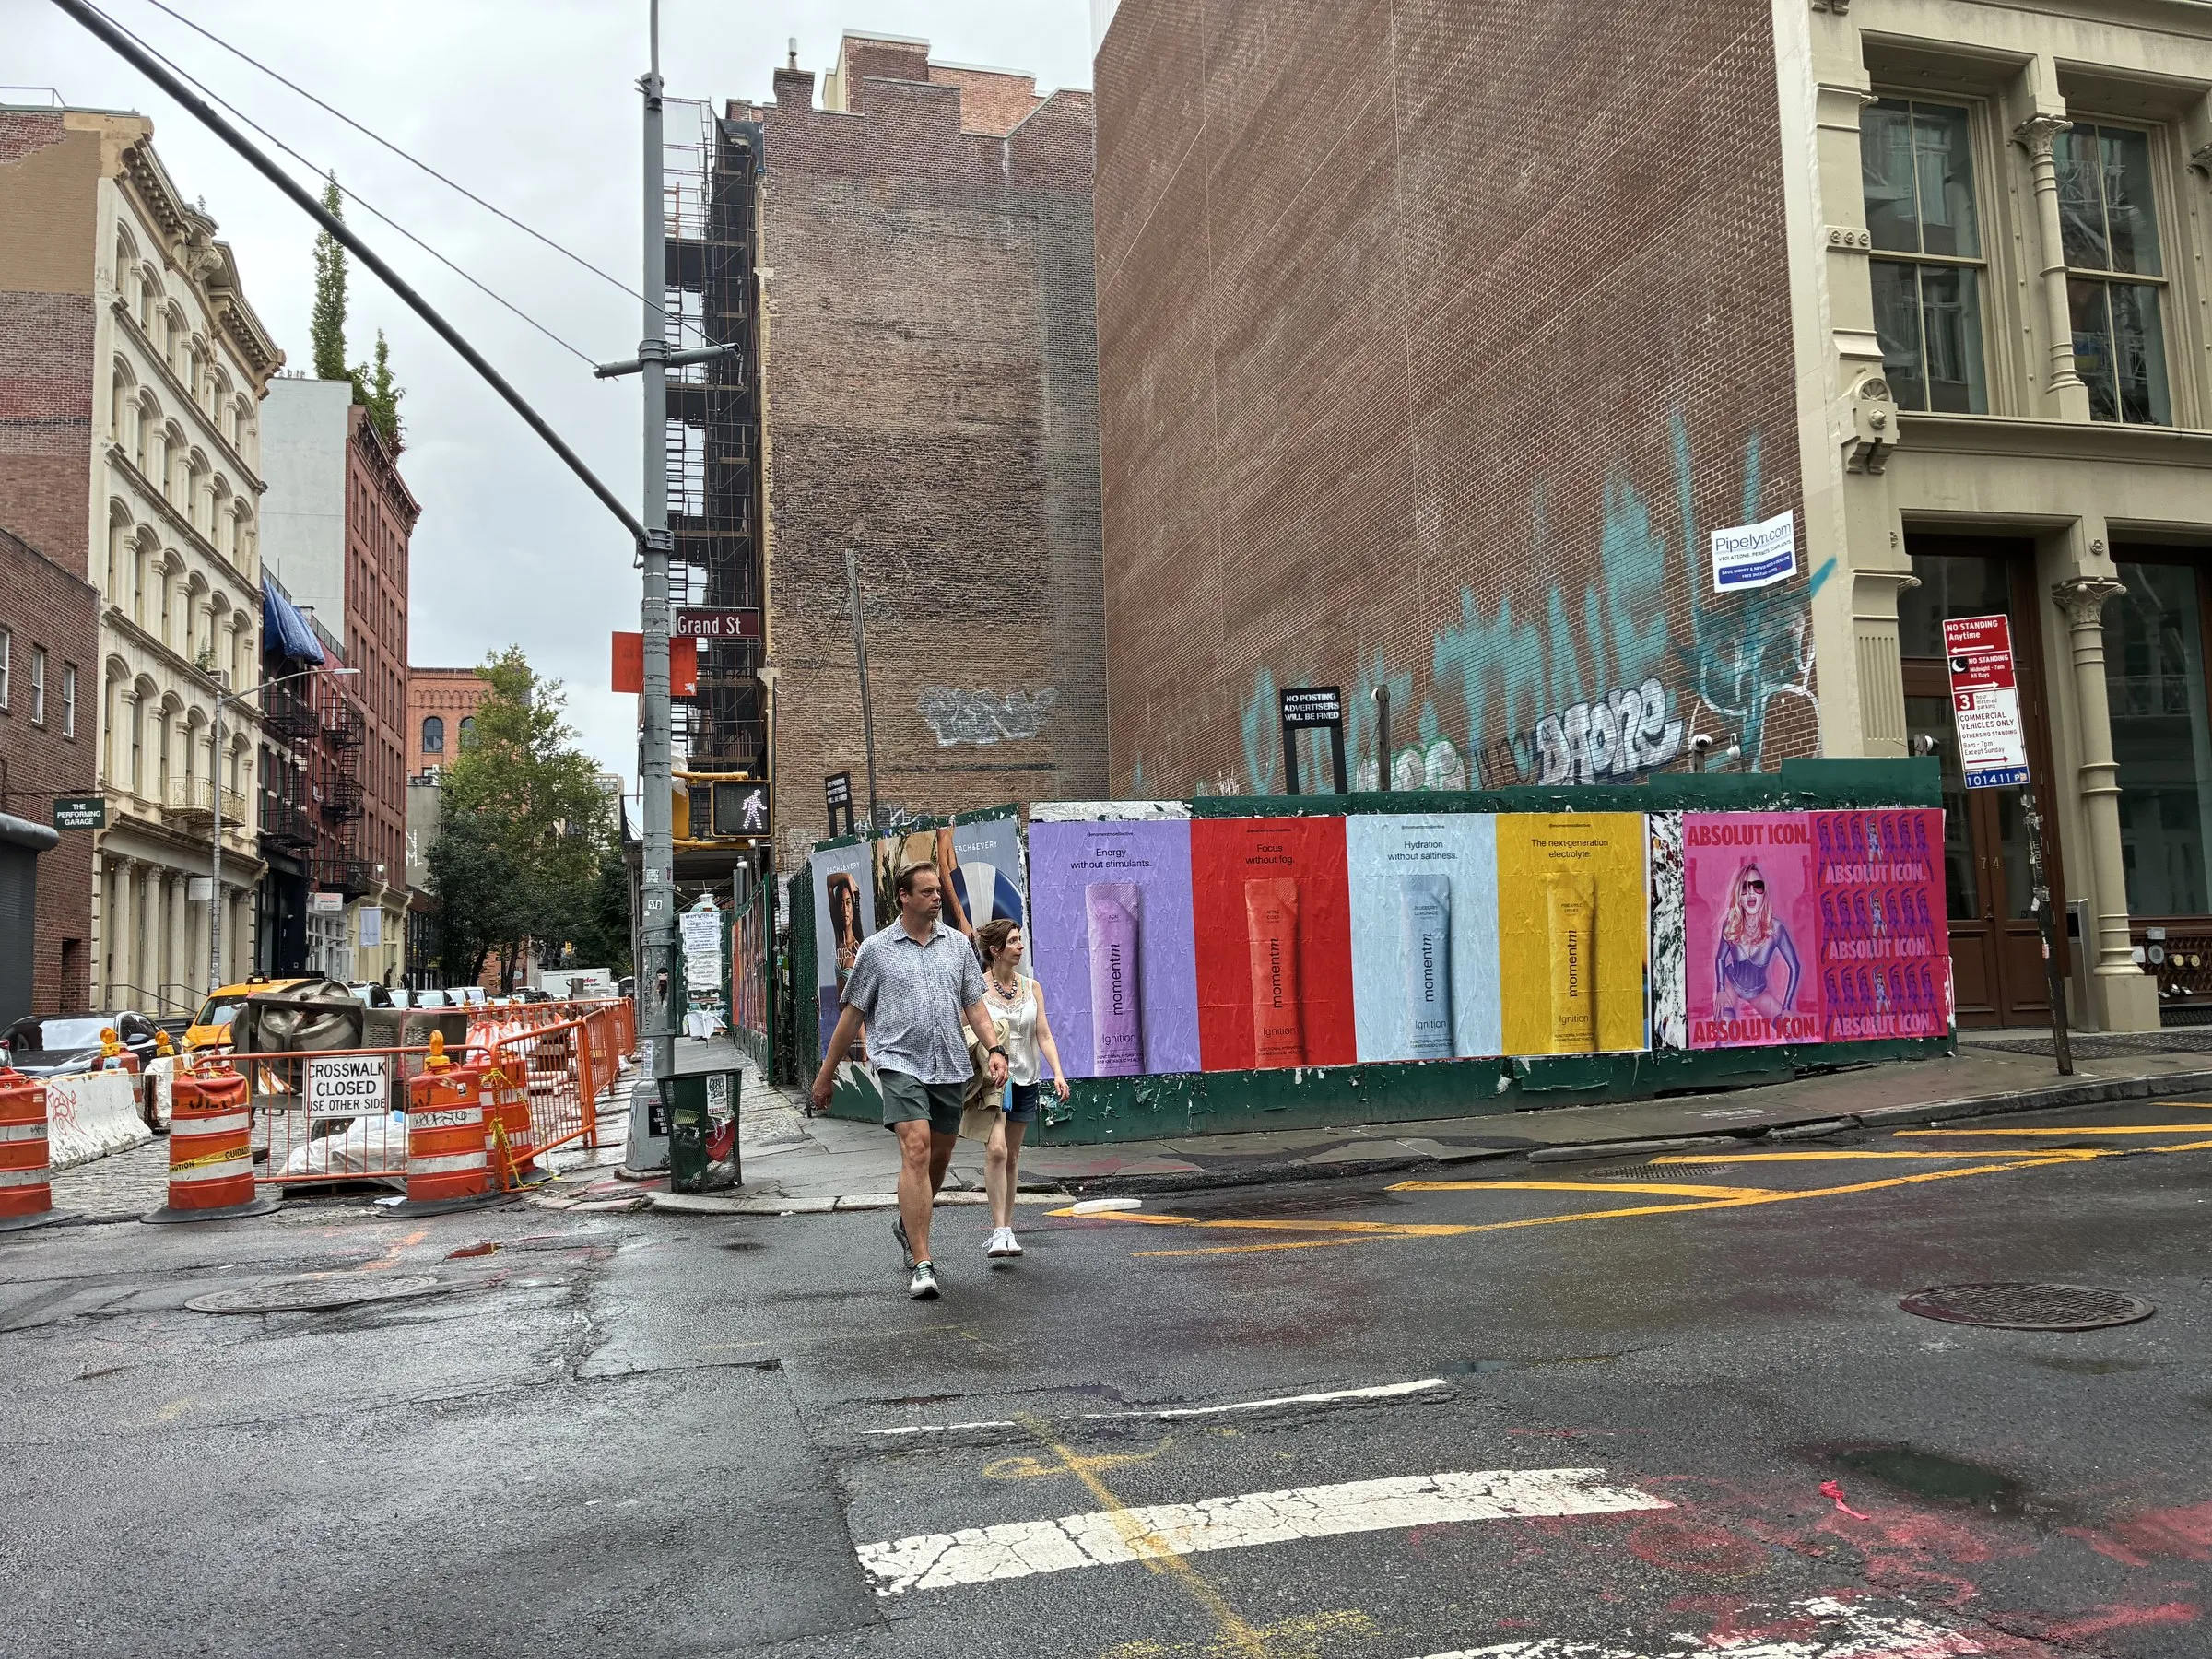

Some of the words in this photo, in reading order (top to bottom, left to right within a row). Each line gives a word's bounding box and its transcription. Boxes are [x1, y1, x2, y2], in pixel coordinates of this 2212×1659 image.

[1716, 524, 1791, 552] Pipelyn.com
[677, 615, 719, 634] Grand
[725, 616, 741, 635] St
[1947, 624, 1959, 632] NO
[1959, 619, 1998, 631] STANDING
[1948, 632, 1981, 641] Anytime
[1978, 654, 2009, 664] STANDING
[1300, 693, 1336, 702] POSTING
[1959, 694, 1971, 710] 3
[1284, 702, 1340, 712] ADVERTISERS
[1284, 712, 1304, 722] WILL
[1304, 712, 1315, 721] BE
[1316, 711, 1339, 720] FINED
[1959, 712, 2006, 723] COMMERCIAL
[1960, 721, 1995, 730] VEHICLES
[1996, 719, 2015, 727] ONLY
[1984, 747, 2005, 755] Sunday
[1967, 773, 2010, 786] 101411
[56, 810, 101, 818] PERFORMING
[1688, 824, 1763, 847] ABSOLUT
[1768, 823, 1811, 845] ICON.
[1256, 843, 1283, 853] Focus
[1404, 841, 1443, 851] Hydration
[1531, 839, 1547, 847] The
[1548, 838, 1608, 849] next-generation
[1096, 848, 1127, 858] Energy
[1387, 853, 1418, 861] without
[1420, 851, 1458, 860] saltiness.
[1548, 850, 1592, 859] electrolyte.
[1070, 861, 1104, 869] without
[1105, 859, 1152, 868] stimulants.
[1245, 855, 1277, 865] without
[1279, 854, 1296, 865] fog.
[1993, 856, 2000, 869] 4
[1825, 864, 1888, 884] ABSOLUT
[1891, 863, 1926, 882] ICON.
[1829, 938, 1892, 960] ABSOLUT
[1895, 938, 1931, 957] ICON.
[1422, 933, 1434, 1002] momentm
[1567, 930, 1578, 997] momentm
[1110, 943, 1123, 1016] momentm
[1269, 938, 1283, 1009] momentm
[1415, 1019, 1447, 1031] Ignition
[1559, 1014, 1589, 1026] Ignition
[1833, 1015, 1896, 1037] ABSOLUT
[1899, 1013, 1935, 1033] ICON.
[1263, 1027, 1296, 1039] Ignition
[1692, 1018, 1772, 1044] ABSOLUT
[1776, 1017, 1821, 1039] ICON.
[1102, 1032, 1136, 1046] Ignition
[309, 1062, 386, 1078] CROSSWALK
[316, 1080, 377, 1097] CLOSED
[328, 1100, 359, 1111] OTHER
[364, 1098, 385, 1110] SIDE
